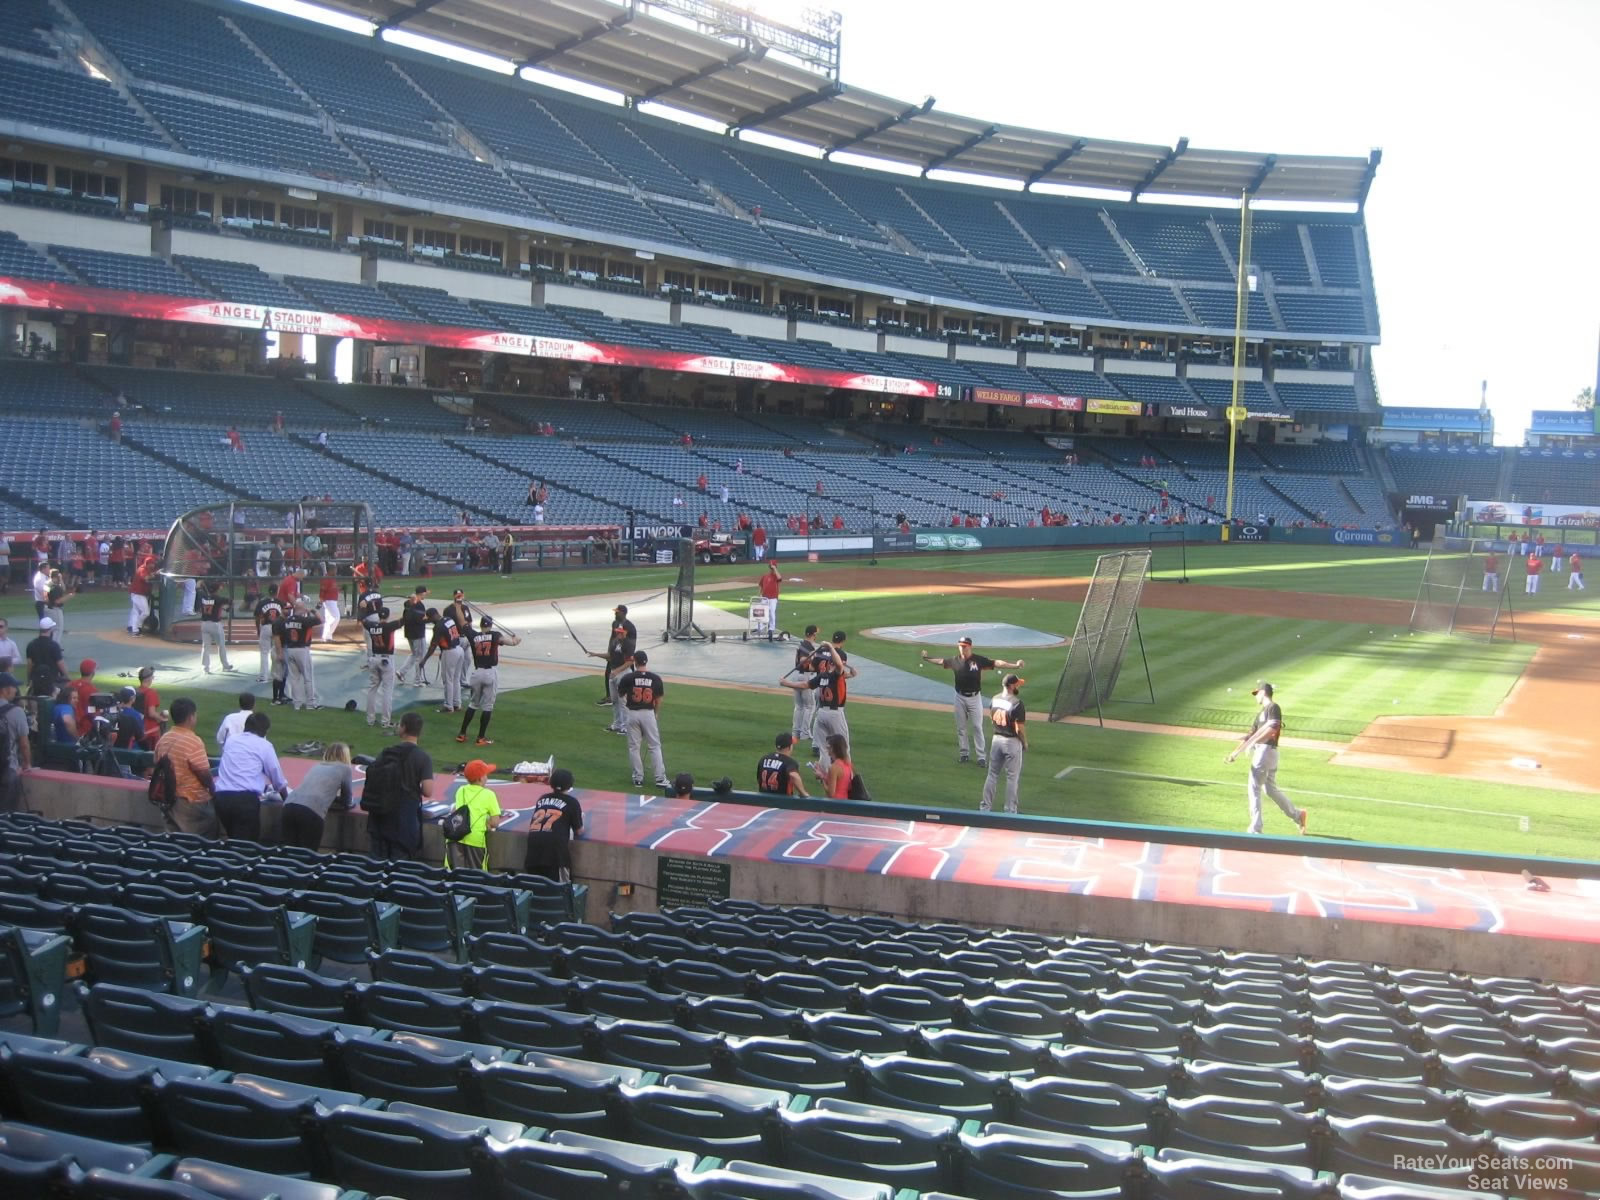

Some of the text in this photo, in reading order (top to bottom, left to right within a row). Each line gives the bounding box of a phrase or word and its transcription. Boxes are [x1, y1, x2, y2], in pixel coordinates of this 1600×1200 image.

[213, 305, 260, 320] ANGEL
[274, 311, 322, 325] STADIUM
[494, 335, 529, 348] ANGEL
[539, 341, 574, 351] STADIUM
[702, 359, 729, 369] ANGEL
[736, 363, 763, 371] STADIUM
[938, 385, 952, 396] 5:10
[976, 391, 999, 401] WELLS
[999, 392, 1021, 403] FARGO
[1171, 406, 1208, 417] Yard House
[1406, 495, 1434, 505] JMG
[1334, 530, 1373, 542] Corona
[761, 769, 779, 790] 14
[537, 797, 567, 810] STANTON
[530, 808, 563, 832] 27
